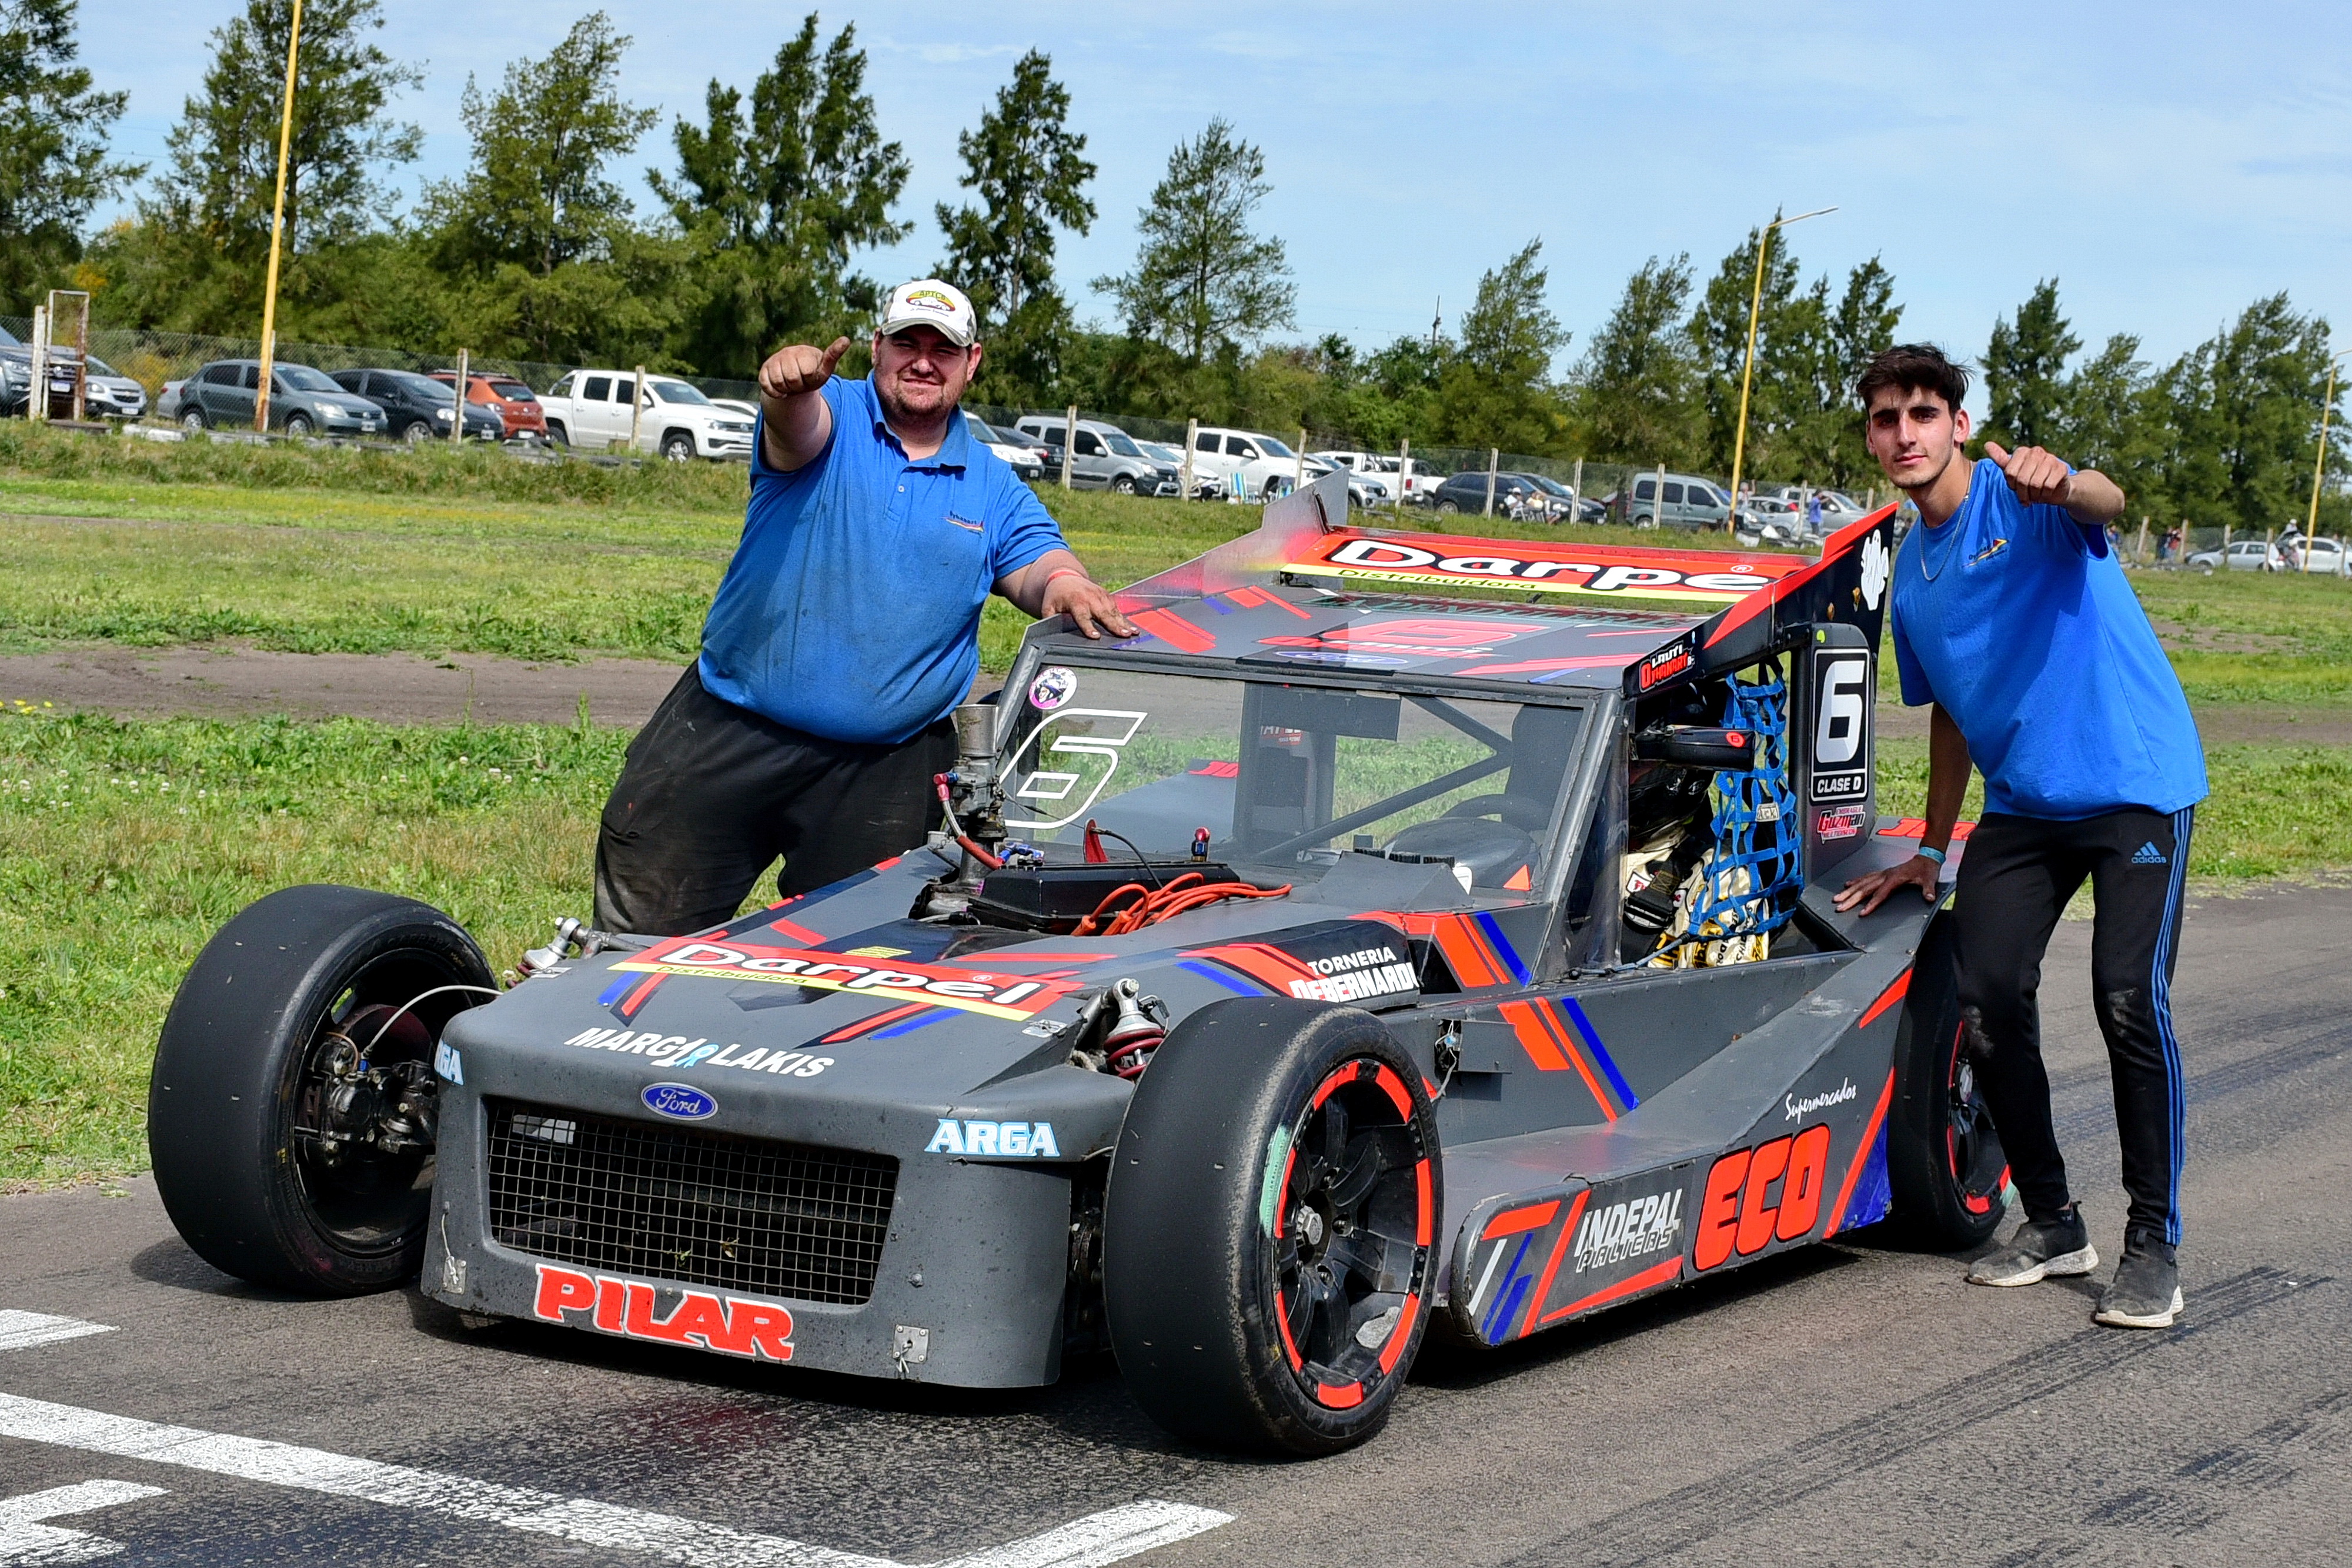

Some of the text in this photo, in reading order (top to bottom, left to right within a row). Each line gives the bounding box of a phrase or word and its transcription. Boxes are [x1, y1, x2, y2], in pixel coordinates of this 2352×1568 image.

[1337, 569, 1536, 589] Distribuidora
[1816, 660, 1865, 763] 6
[998, 708, 1148, 829] 6
[1818, 776, 1862, 793] CLASE D
[2131, 855, 2167, 864] adidas
[656, 966, 808, 984] Distribuidora
[658, 943, 1044, 1005] Darpel
[1307, 946, 1397, 976] TORNERIA
[655, 1088, 701, 1115] Ford
[1785, 1076, 1857, 1125] Supermercados
[925, 1118, 1061, 1157] ARGA
[1692, 1122, 1831, 1272] ECO
[1573, 1188, 1683, 1258] INDEPAL
[534, 1262, 795, 1361] PILAR
